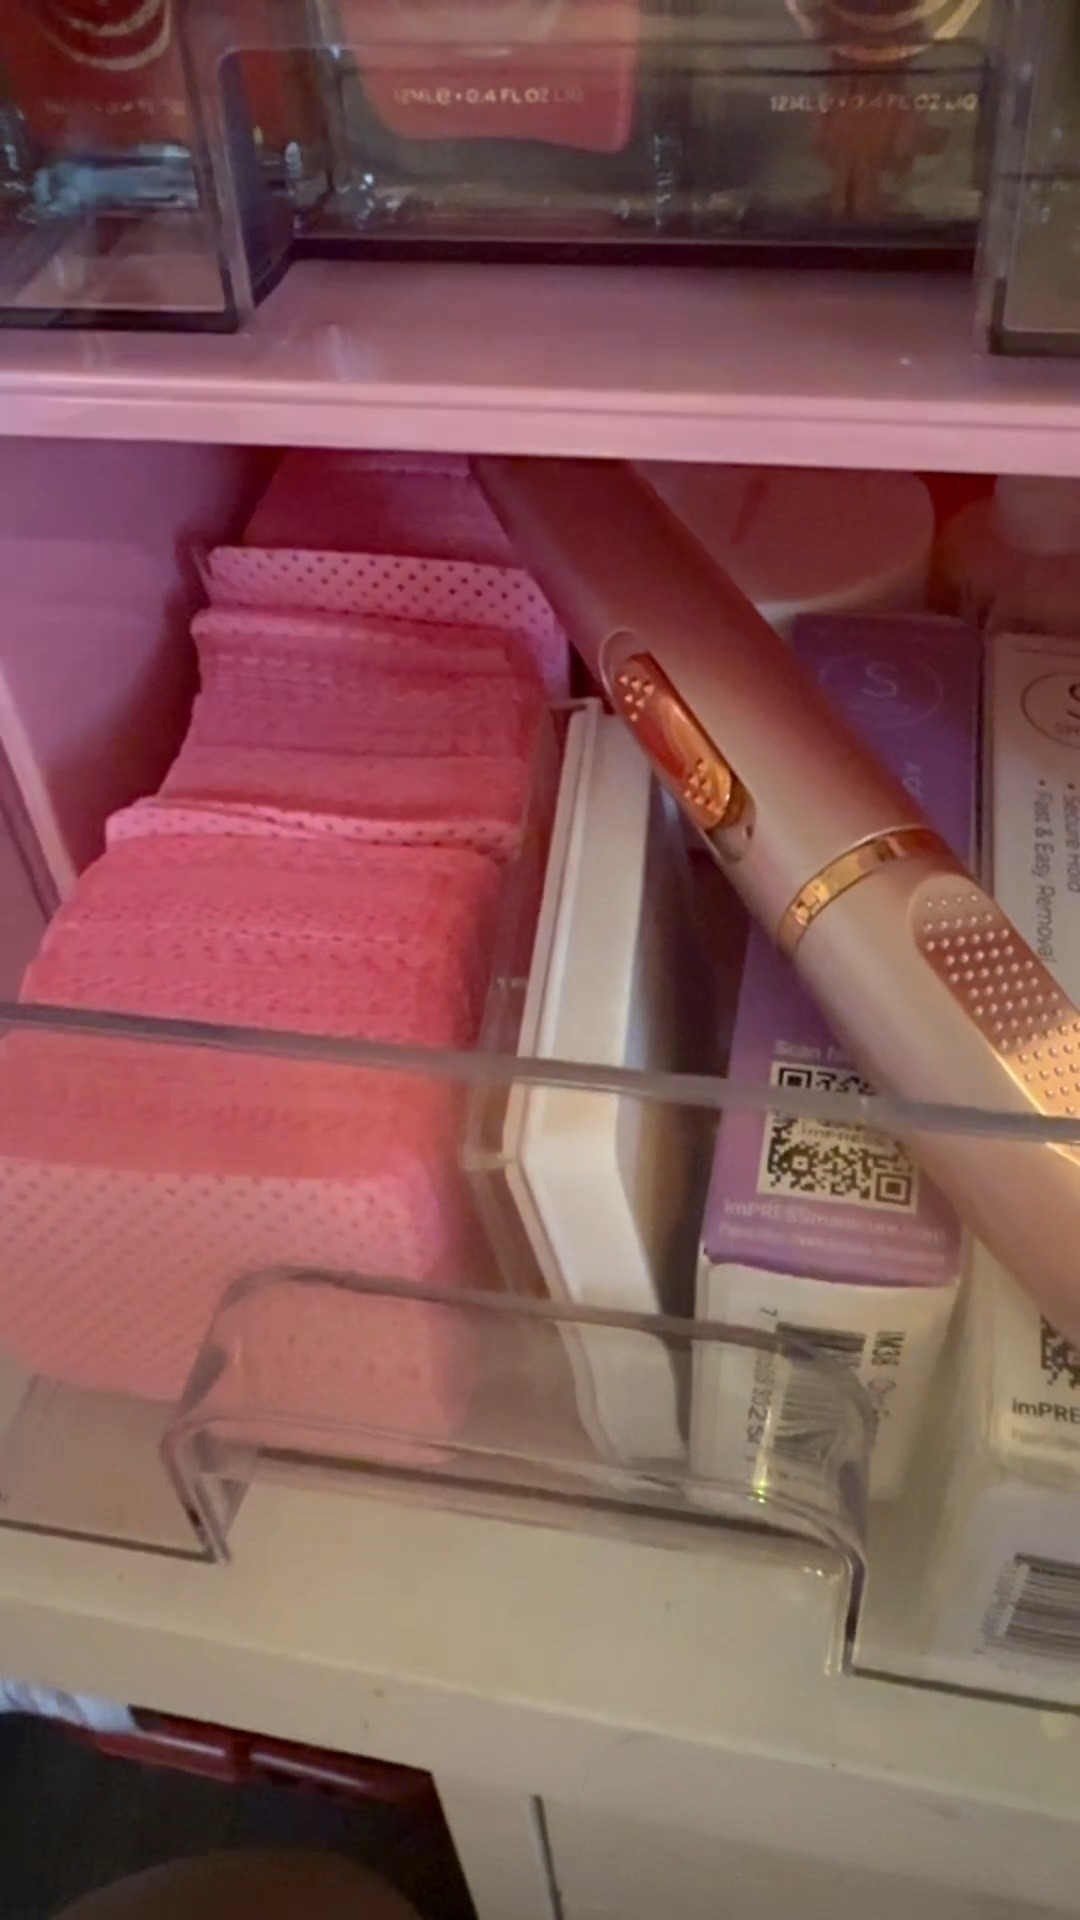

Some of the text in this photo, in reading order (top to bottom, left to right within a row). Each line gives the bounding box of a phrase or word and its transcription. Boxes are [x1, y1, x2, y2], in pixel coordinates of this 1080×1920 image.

[1034, 792, 1053, 823] Fast
[1034, 826, 1054, 839] &
[1031, 842, 1054, 879] Easy
